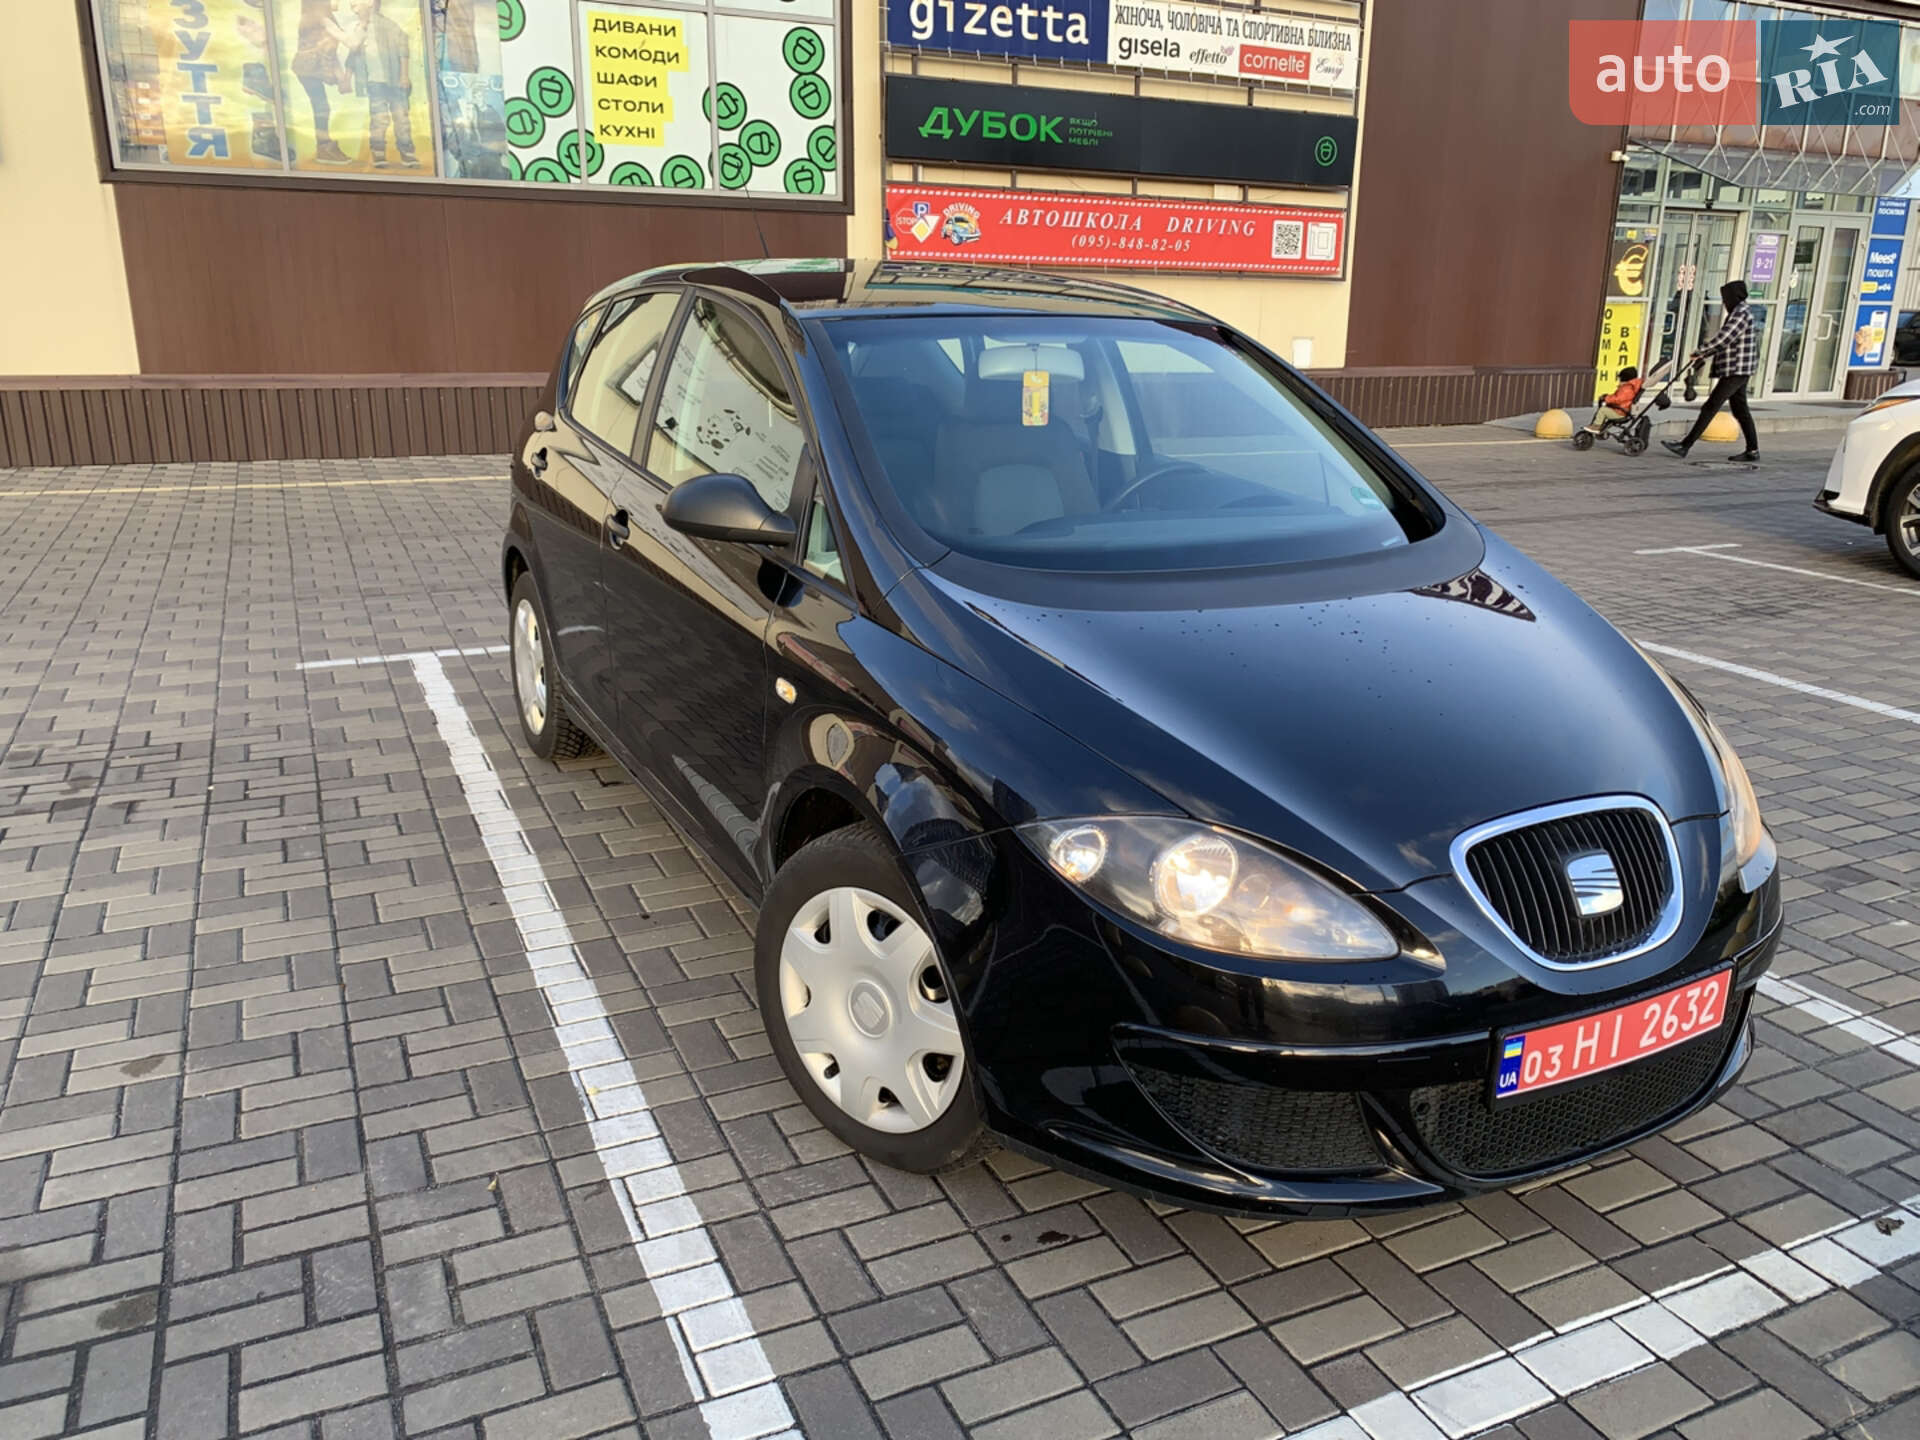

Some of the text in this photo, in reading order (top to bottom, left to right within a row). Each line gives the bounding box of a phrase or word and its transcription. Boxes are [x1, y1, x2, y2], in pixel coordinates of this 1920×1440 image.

[593, 18, 677, 38] ДИВАНИ
[909, 0, 1090, 45] gizetta
[1115, 5, 1352, 51] ЖІНОЧА, ЧОЛОВІЧА ТА СПОРТИВНА БІЛИЗНА
[595, 45, 680, 65] КОМОДИ
[1119, 37, 1181, 60] gisela
[1189, 48, 1228, 64] effetto
[169, 0, 229, 158] ЗУТТЯ
[597, 72, 658, 88] ШАФИ
[598, 98, 664, 114] СТОЛИ
[599, 124, 656, 139] КУХНІ
[918, 106, 1064, 143] ДУБОК
[999, 208, 1256, 236] АВТОШКОЛА DRIVING
[1599, 308, 1613, 382] ОБМІН
[1615, 326, 1631, 381] ВАЛ
[1639, 980, 1720, 1049] 2632
[1499, 1073, 1517, 1089] UA
